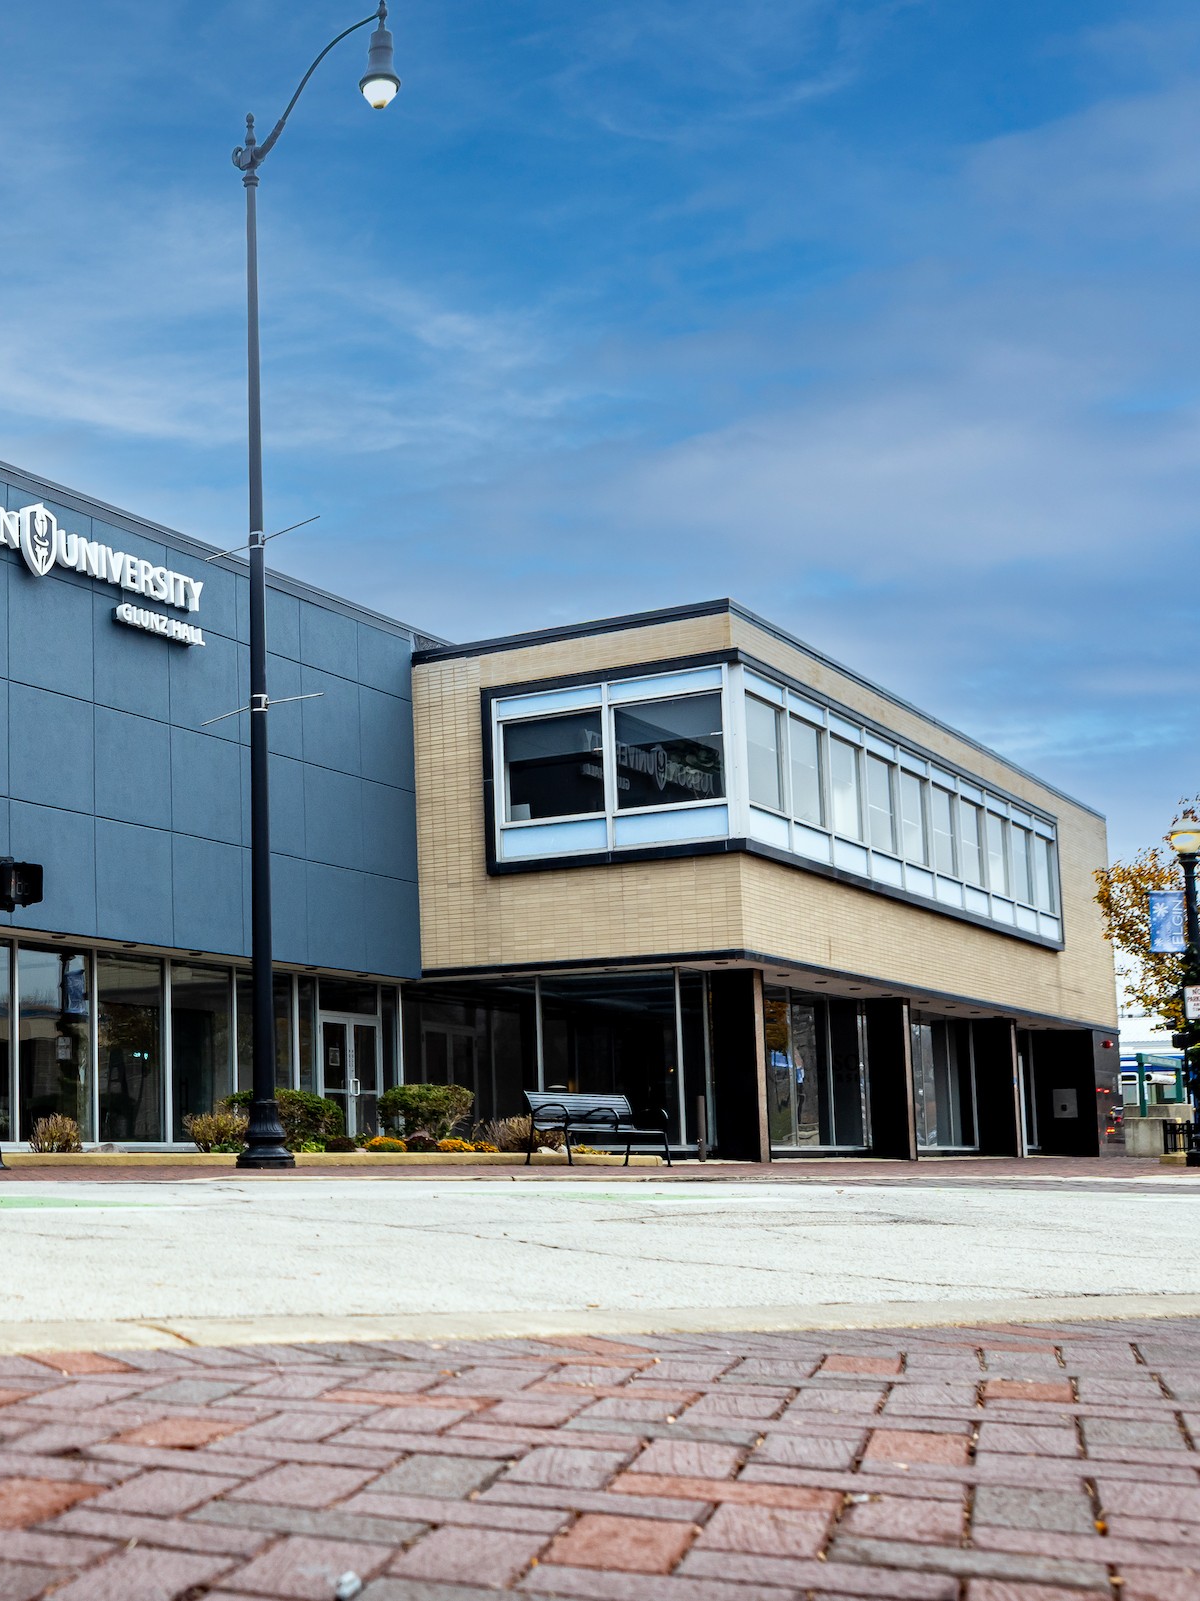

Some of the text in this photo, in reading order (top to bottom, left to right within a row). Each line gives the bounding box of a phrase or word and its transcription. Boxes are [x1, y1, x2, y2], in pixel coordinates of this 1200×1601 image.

[55, 529, 204, 612] UNIVERSITY
[116, 603, 206, 646] GLUNZ HALL
[1172, 899, 1184, 945] ELGIN
